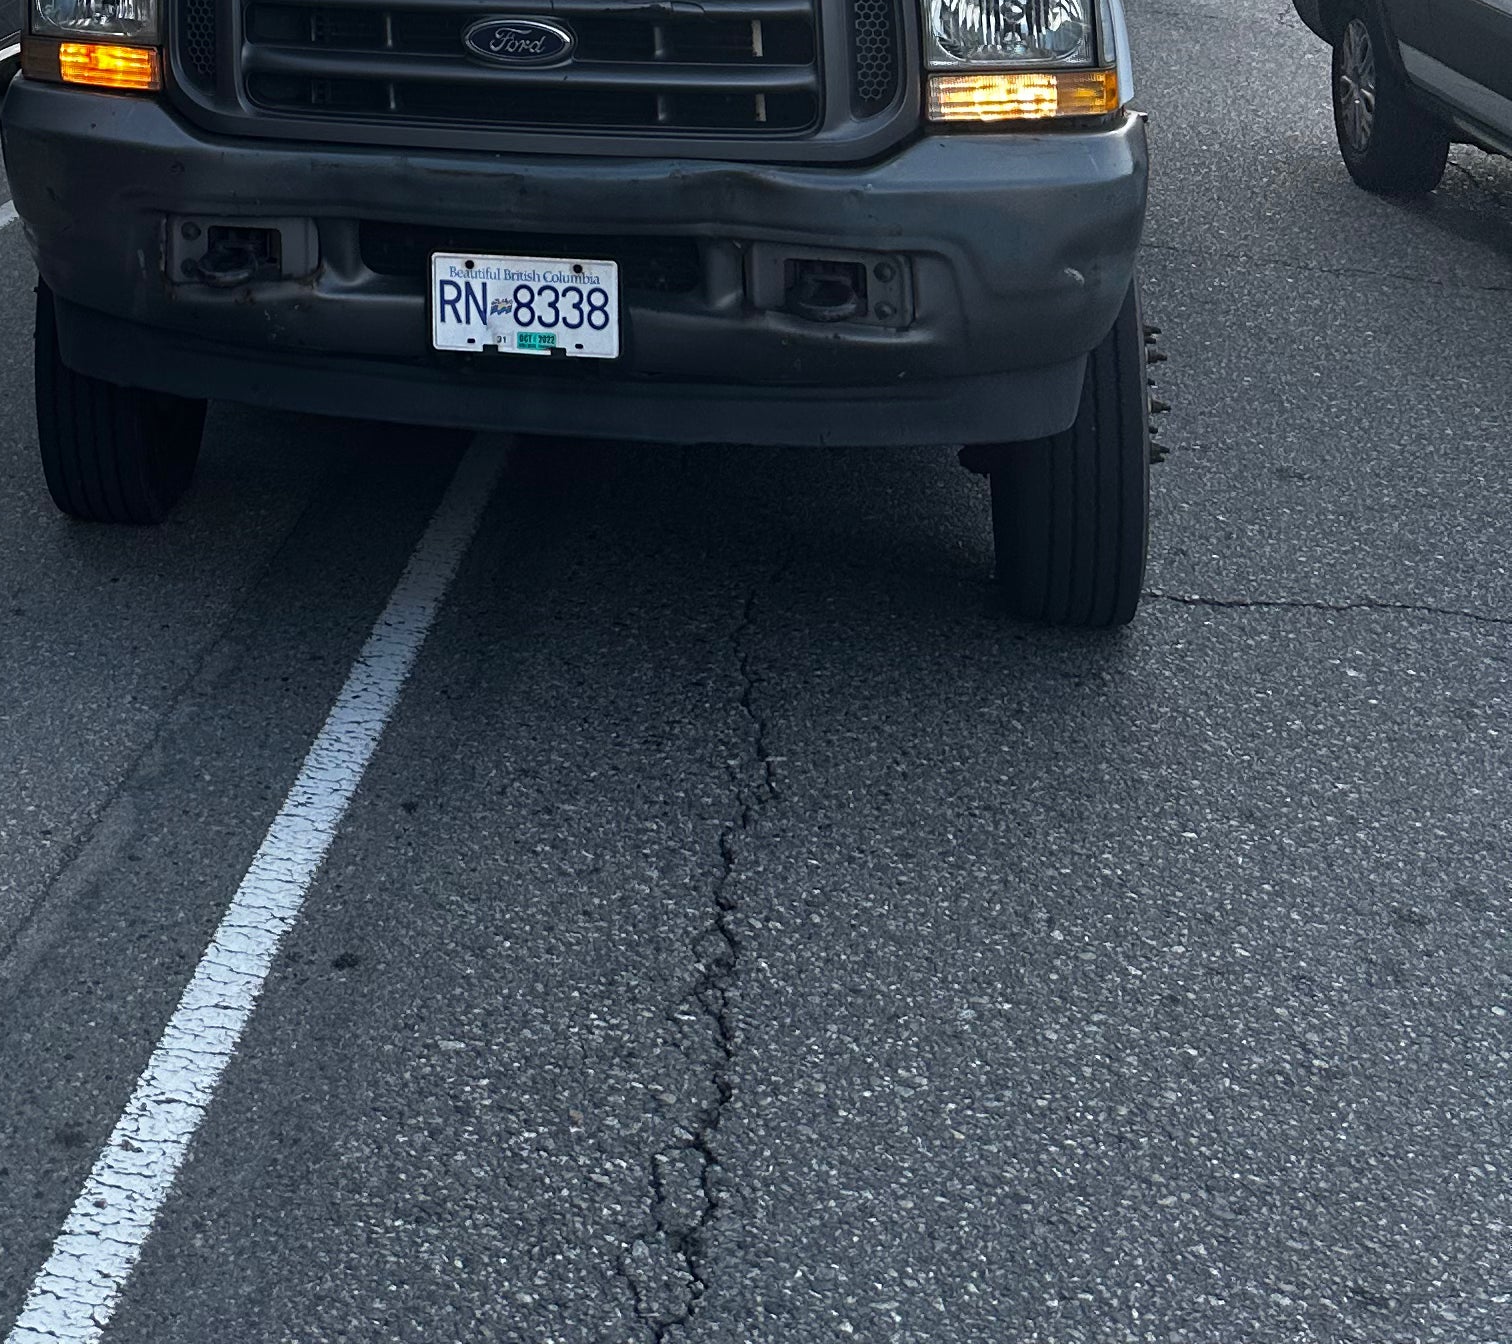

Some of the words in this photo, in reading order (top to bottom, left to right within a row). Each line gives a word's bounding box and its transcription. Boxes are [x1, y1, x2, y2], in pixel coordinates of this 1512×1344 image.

[489, 27, 546, 53] Ford
[449, 266, 501, 281] Beautiful
[503, 269, 540, 282] British
[542, 271, 600, 285] Columbia
[439, 279, 488, 326] RN
[513, 283, 610, 330] 8338
[519, 334, 532, 343] OCT
